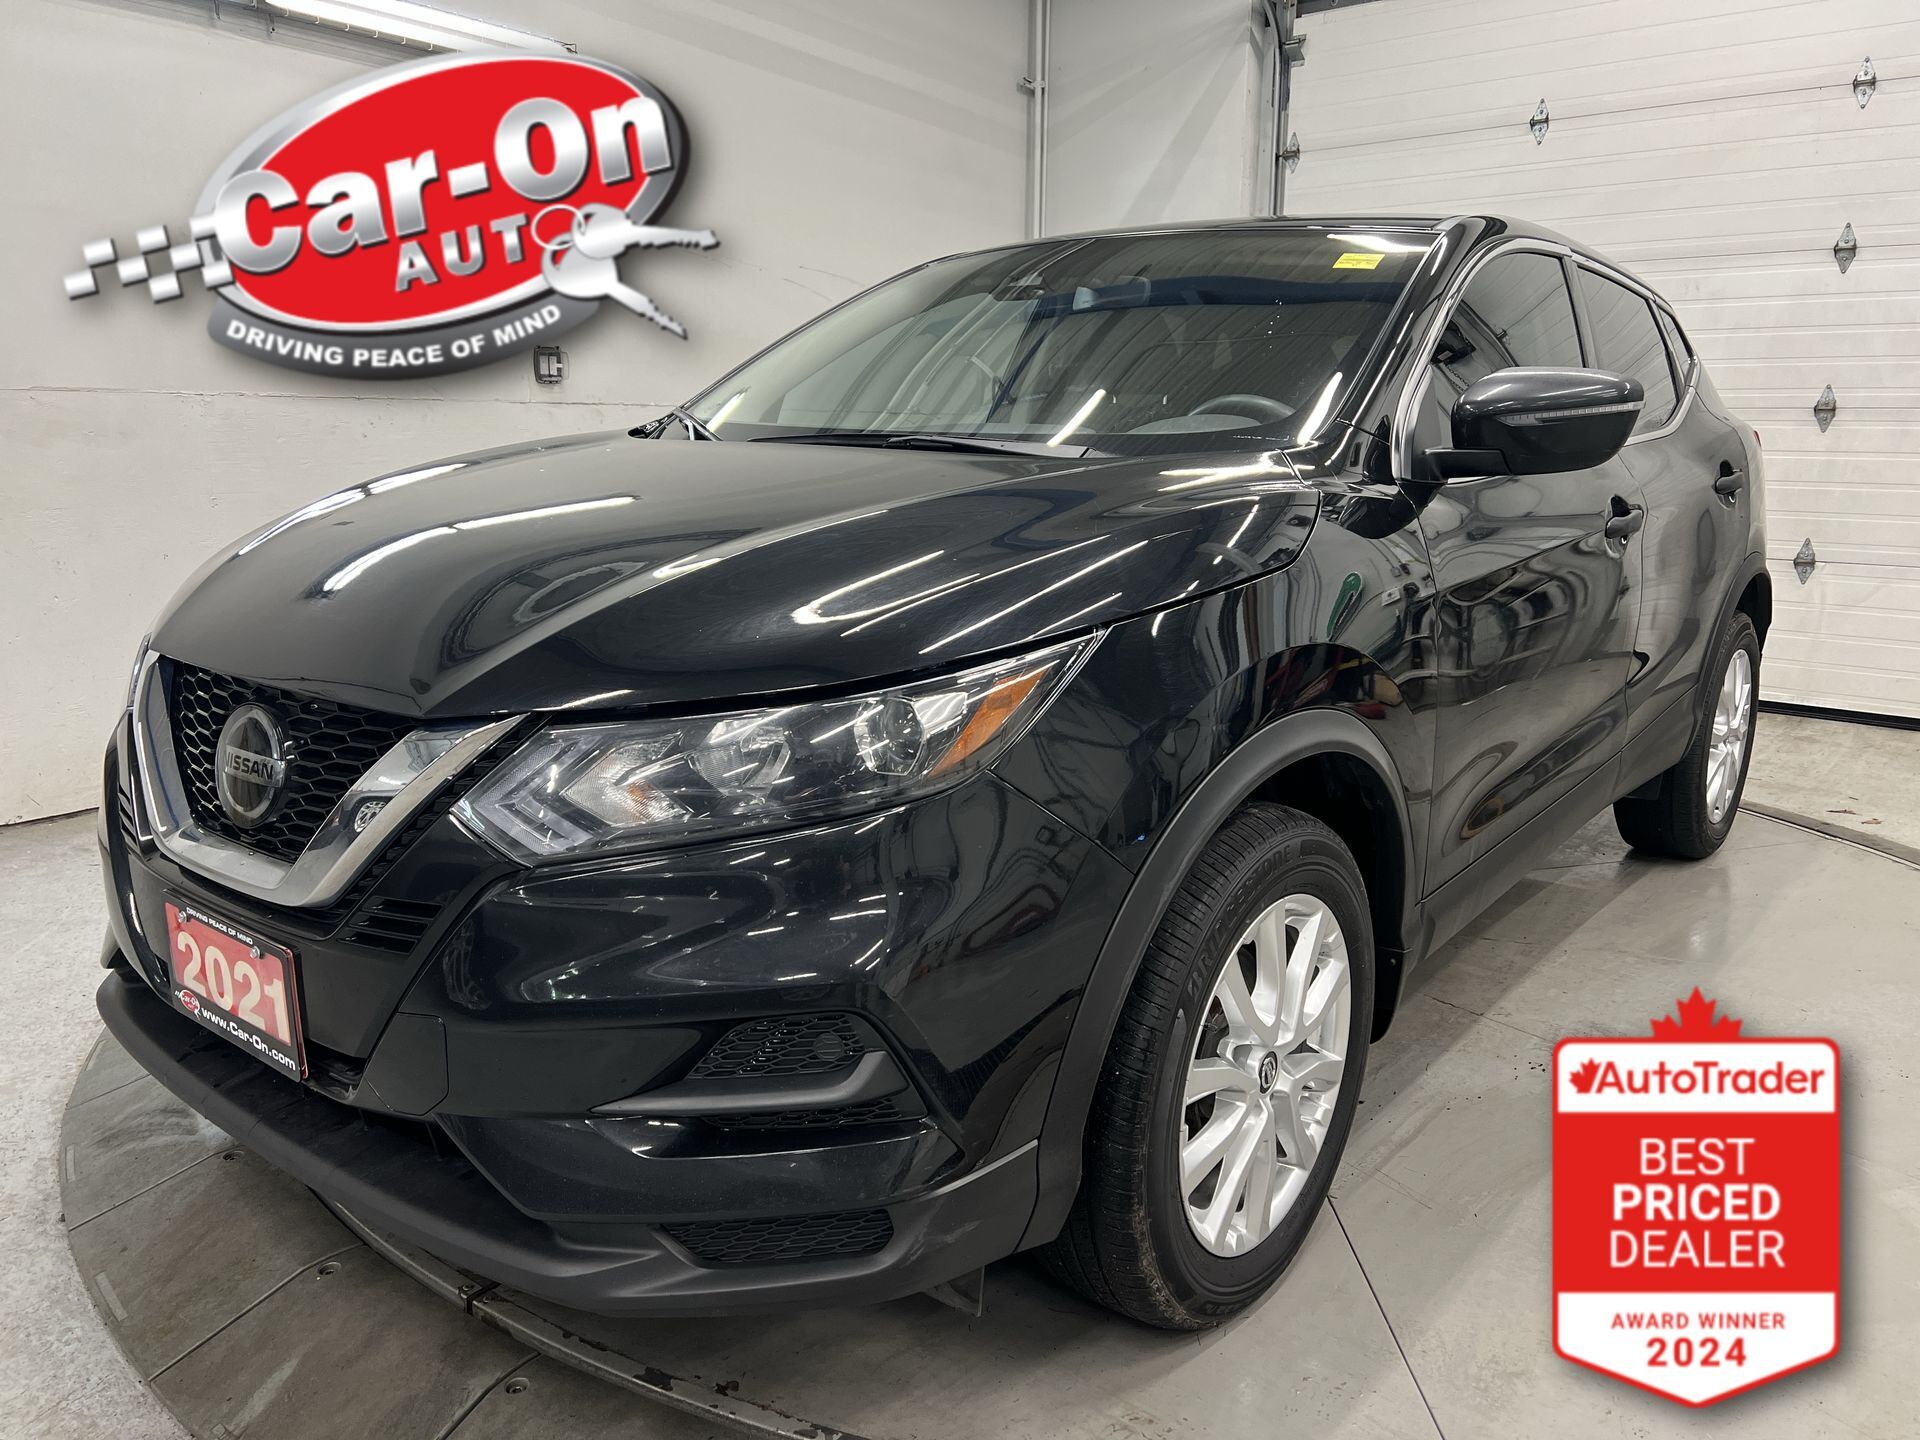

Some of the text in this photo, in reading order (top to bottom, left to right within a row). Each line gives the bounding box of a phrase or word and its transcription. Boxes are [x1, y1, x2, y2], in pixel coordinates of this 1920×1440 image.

[186, 906, 208, 923] DRIVING
[209, 918, 227, 932] PEACE
[228, 927, 236, 937] OF
[177, 931, 291, 1047] 2021
[201, 1007, 296, 1070] www.Car-On.com
